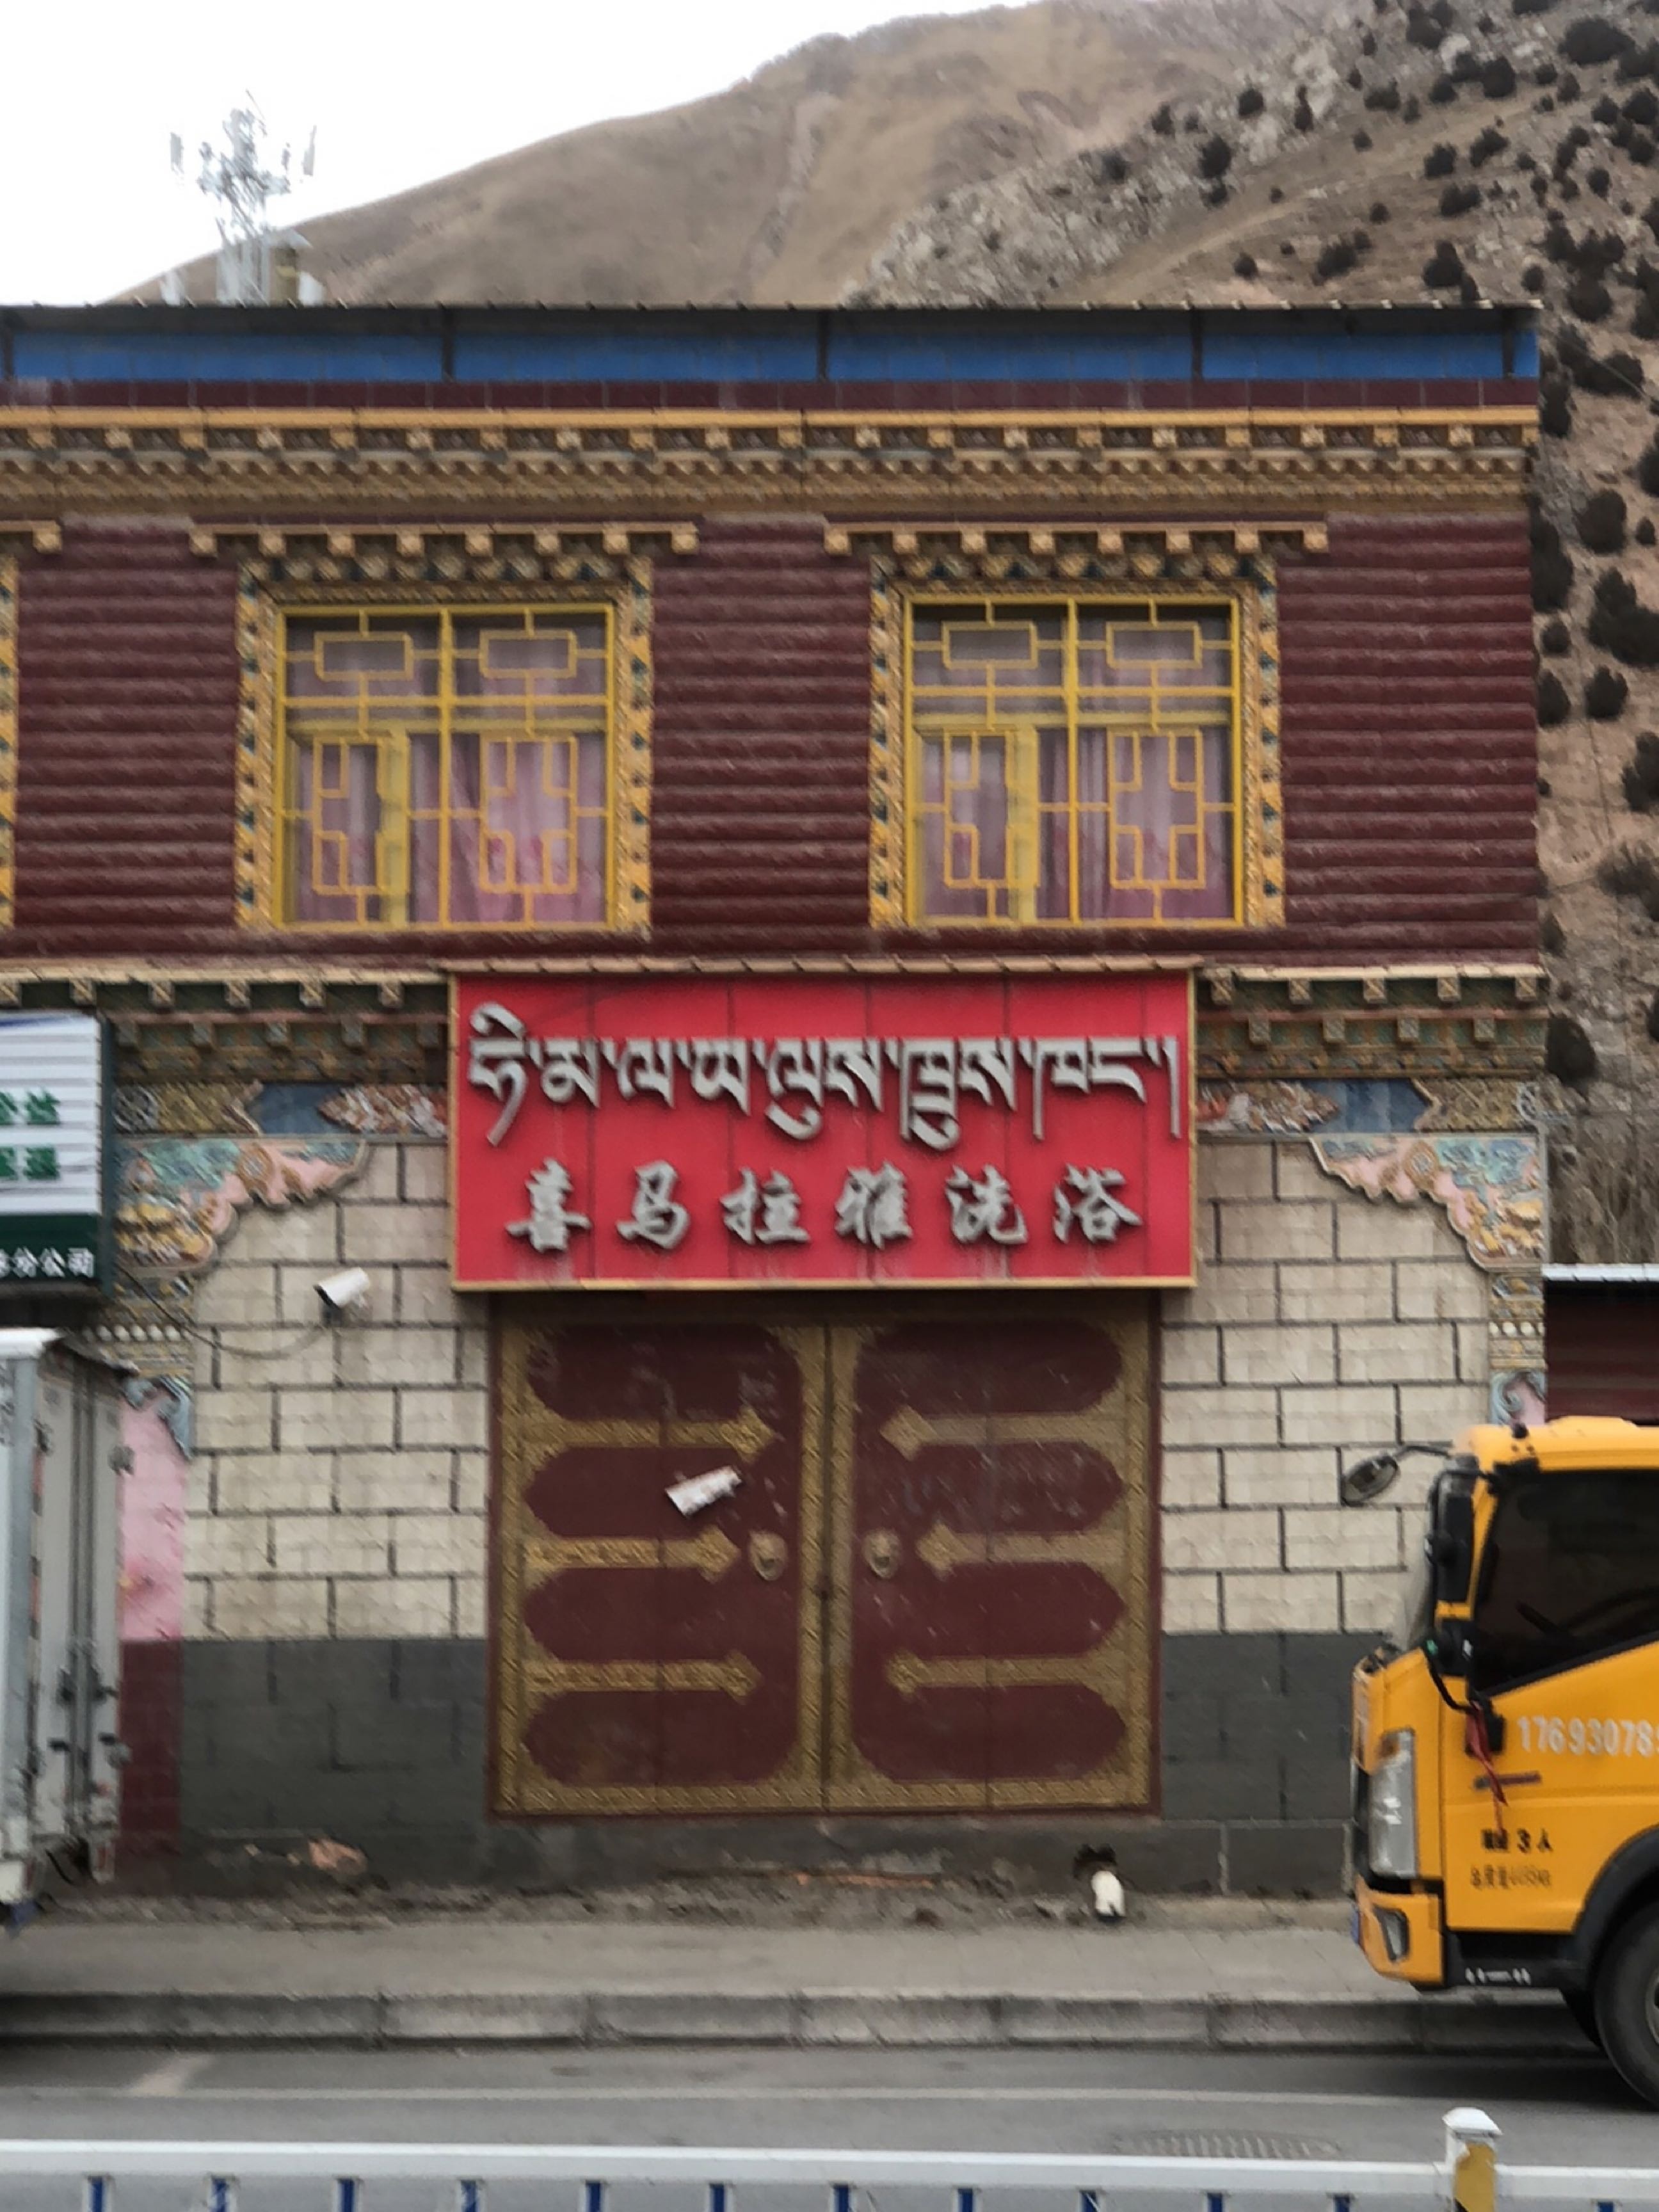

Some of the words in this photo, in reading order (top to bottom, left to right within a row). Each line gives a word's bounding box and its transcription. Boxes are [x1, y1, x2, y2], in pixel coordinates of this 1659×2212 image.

[506, 1157, 1142, 1251] 喜马拉雅洗浴
[1518, 1715, 1659, 1758] 17693078
